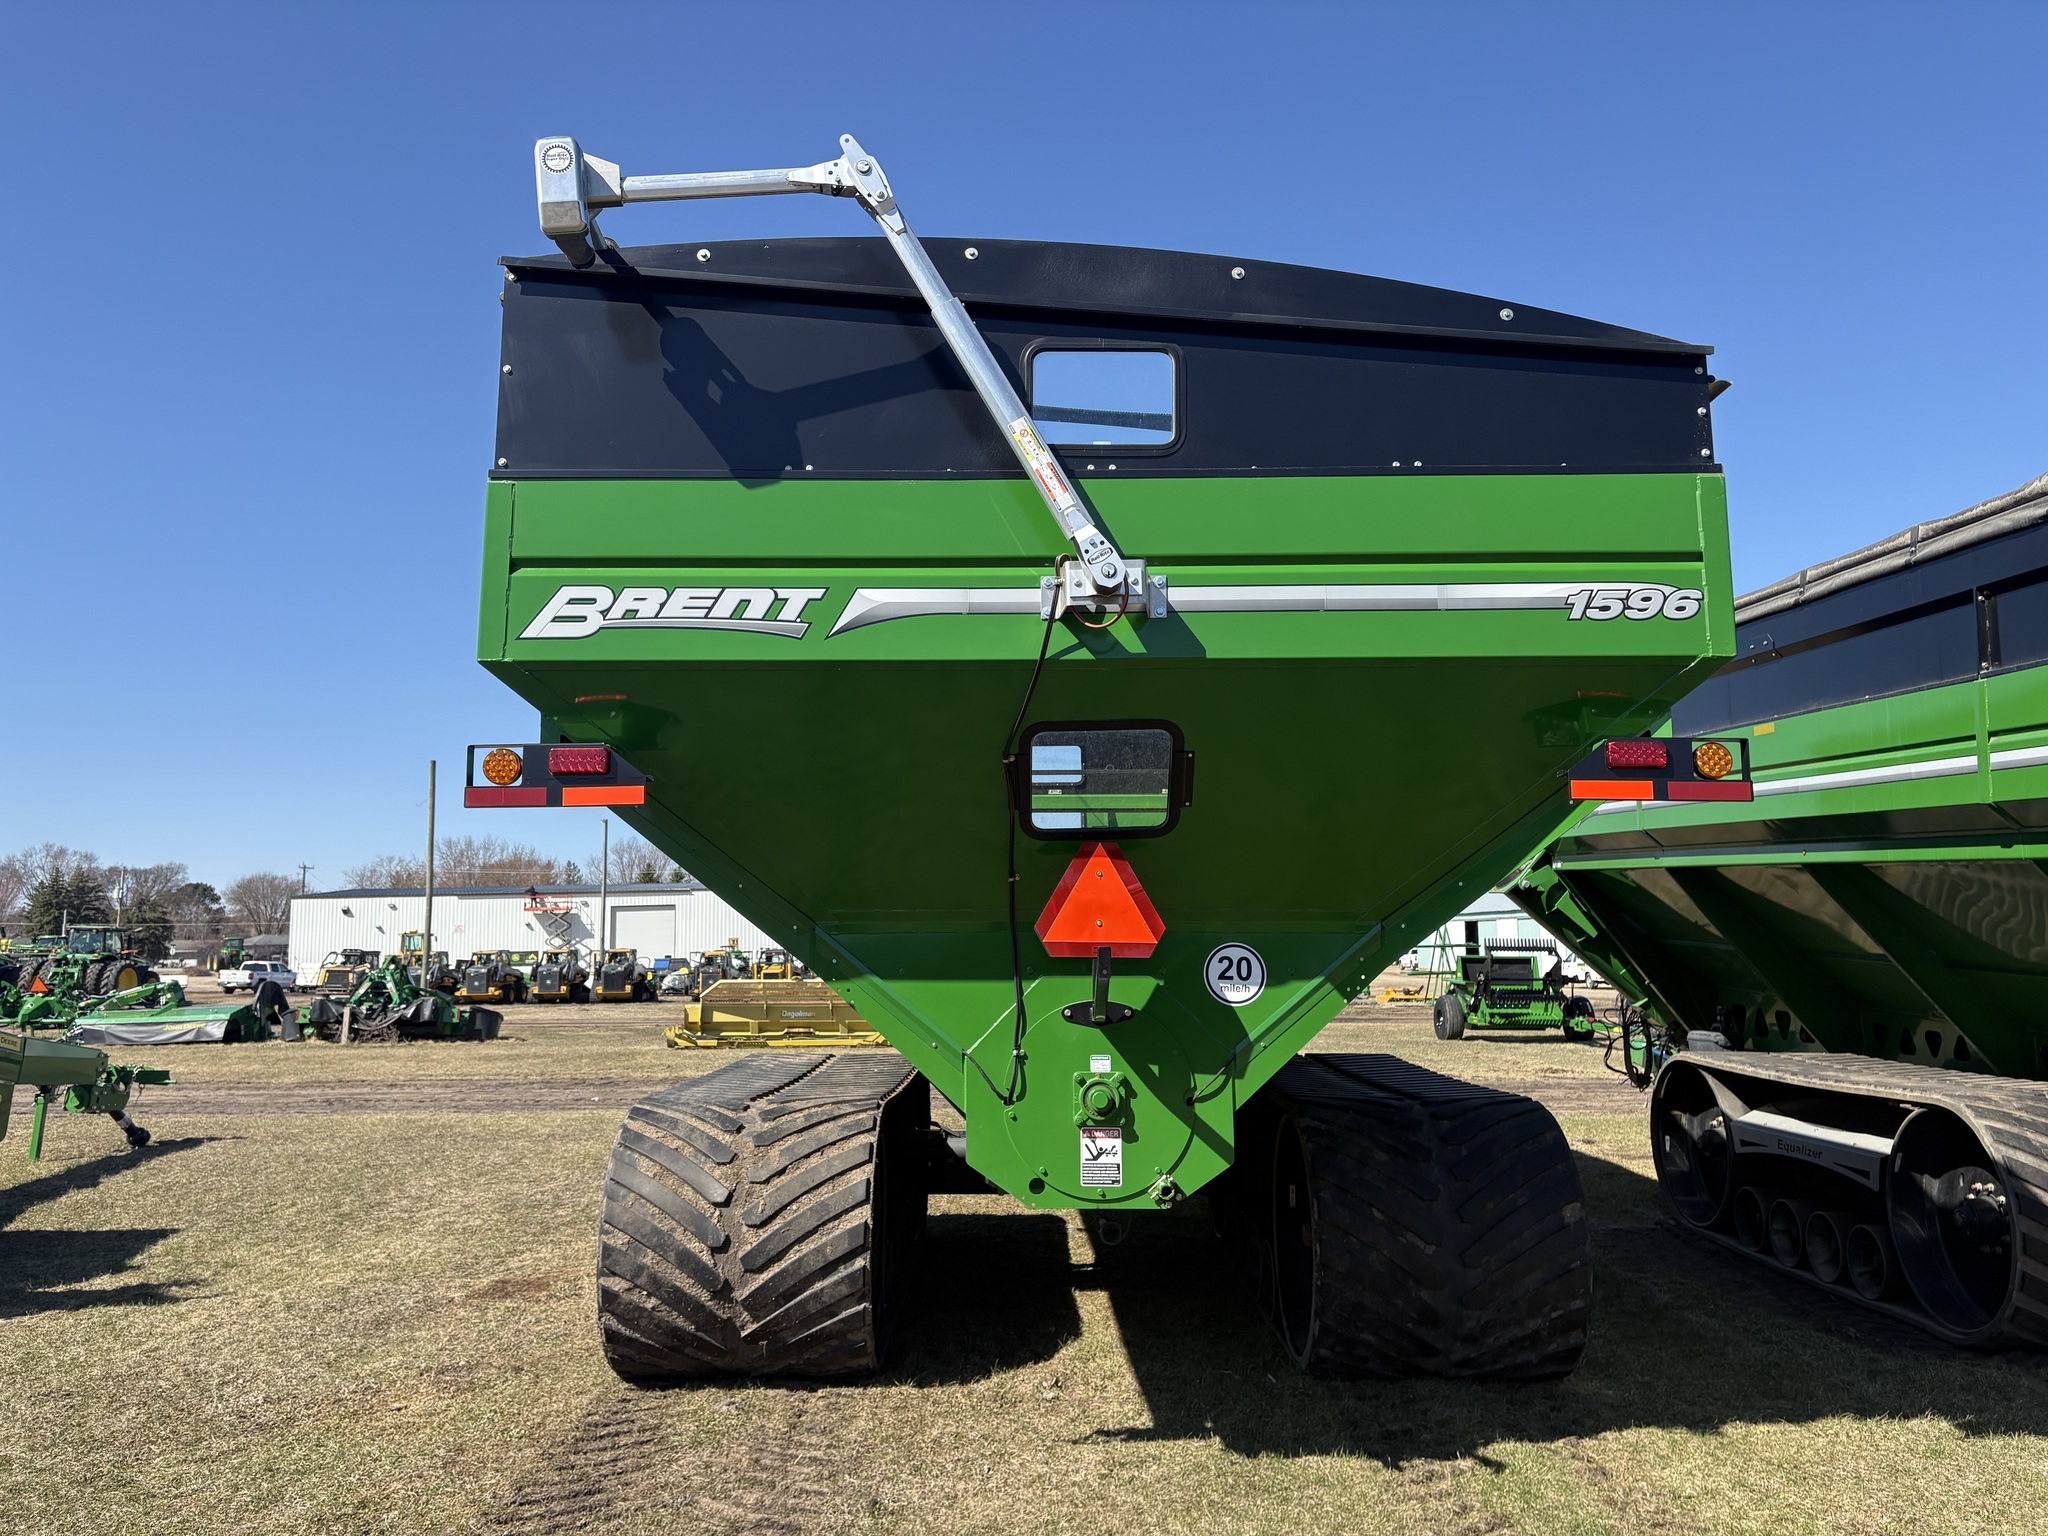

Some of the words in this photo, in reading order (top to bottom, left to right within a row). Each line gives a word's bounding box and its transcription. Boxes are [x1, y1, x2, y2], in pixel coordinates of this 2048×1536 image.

[515, 585, 830, 640] BRENT
[1564, 588, 1704, 621] 1596
[1217, 956, 1252, 981] 20
[1220, 984, 1251, 993] mile/h
[0, 1036, 18, 1047] DEERE
[1091, 1130, 1119, 1138] DANGER
[1777, 1139, 1823, 1159] Equalizer
